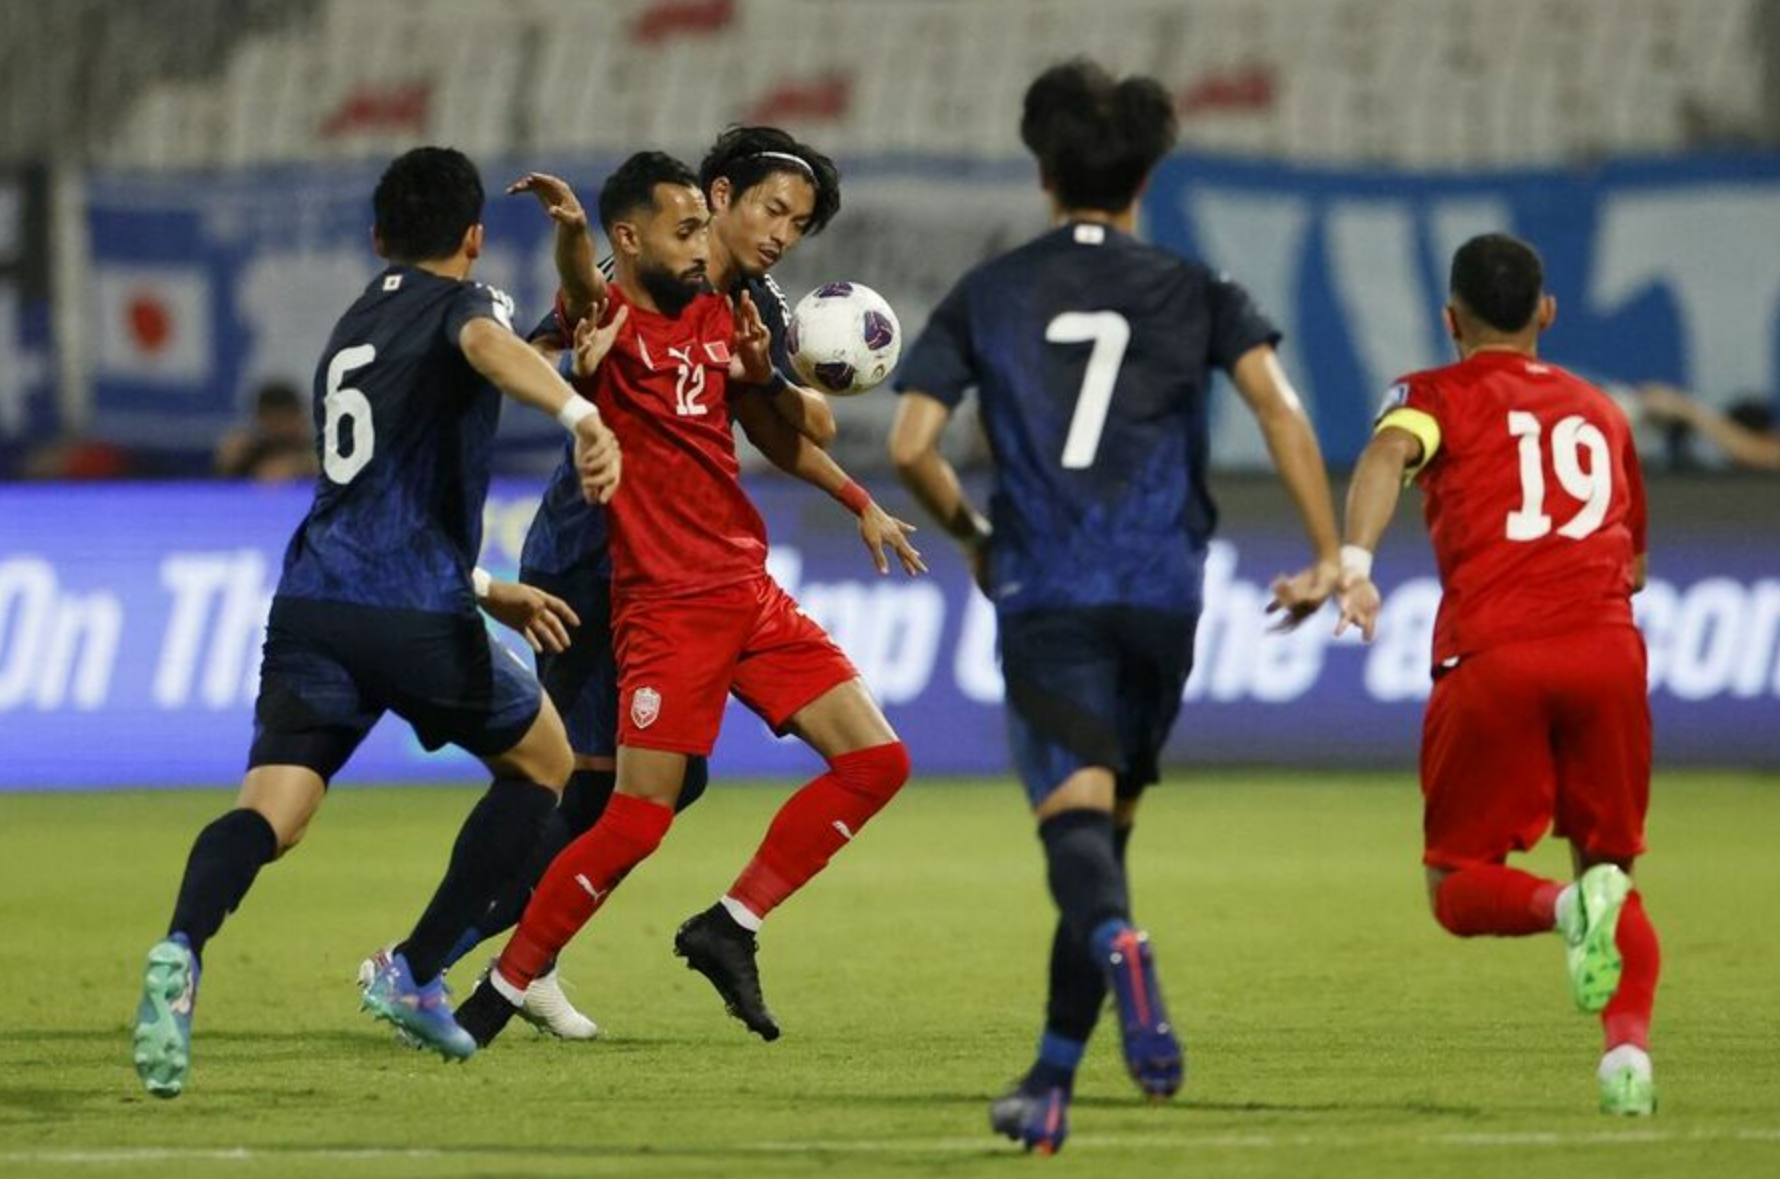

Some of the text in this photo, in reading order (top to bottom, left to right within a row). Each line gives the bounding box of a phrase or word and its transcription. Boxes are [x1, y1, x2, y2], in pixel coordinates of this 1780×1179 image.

[323, 343, 376, 485] 6
[676, 363, 708, 415] 12
[1045, 311, 1131, 469] 7
[1506, 410, 1612, 541] 19
[153, 549, 272, 710] Th
